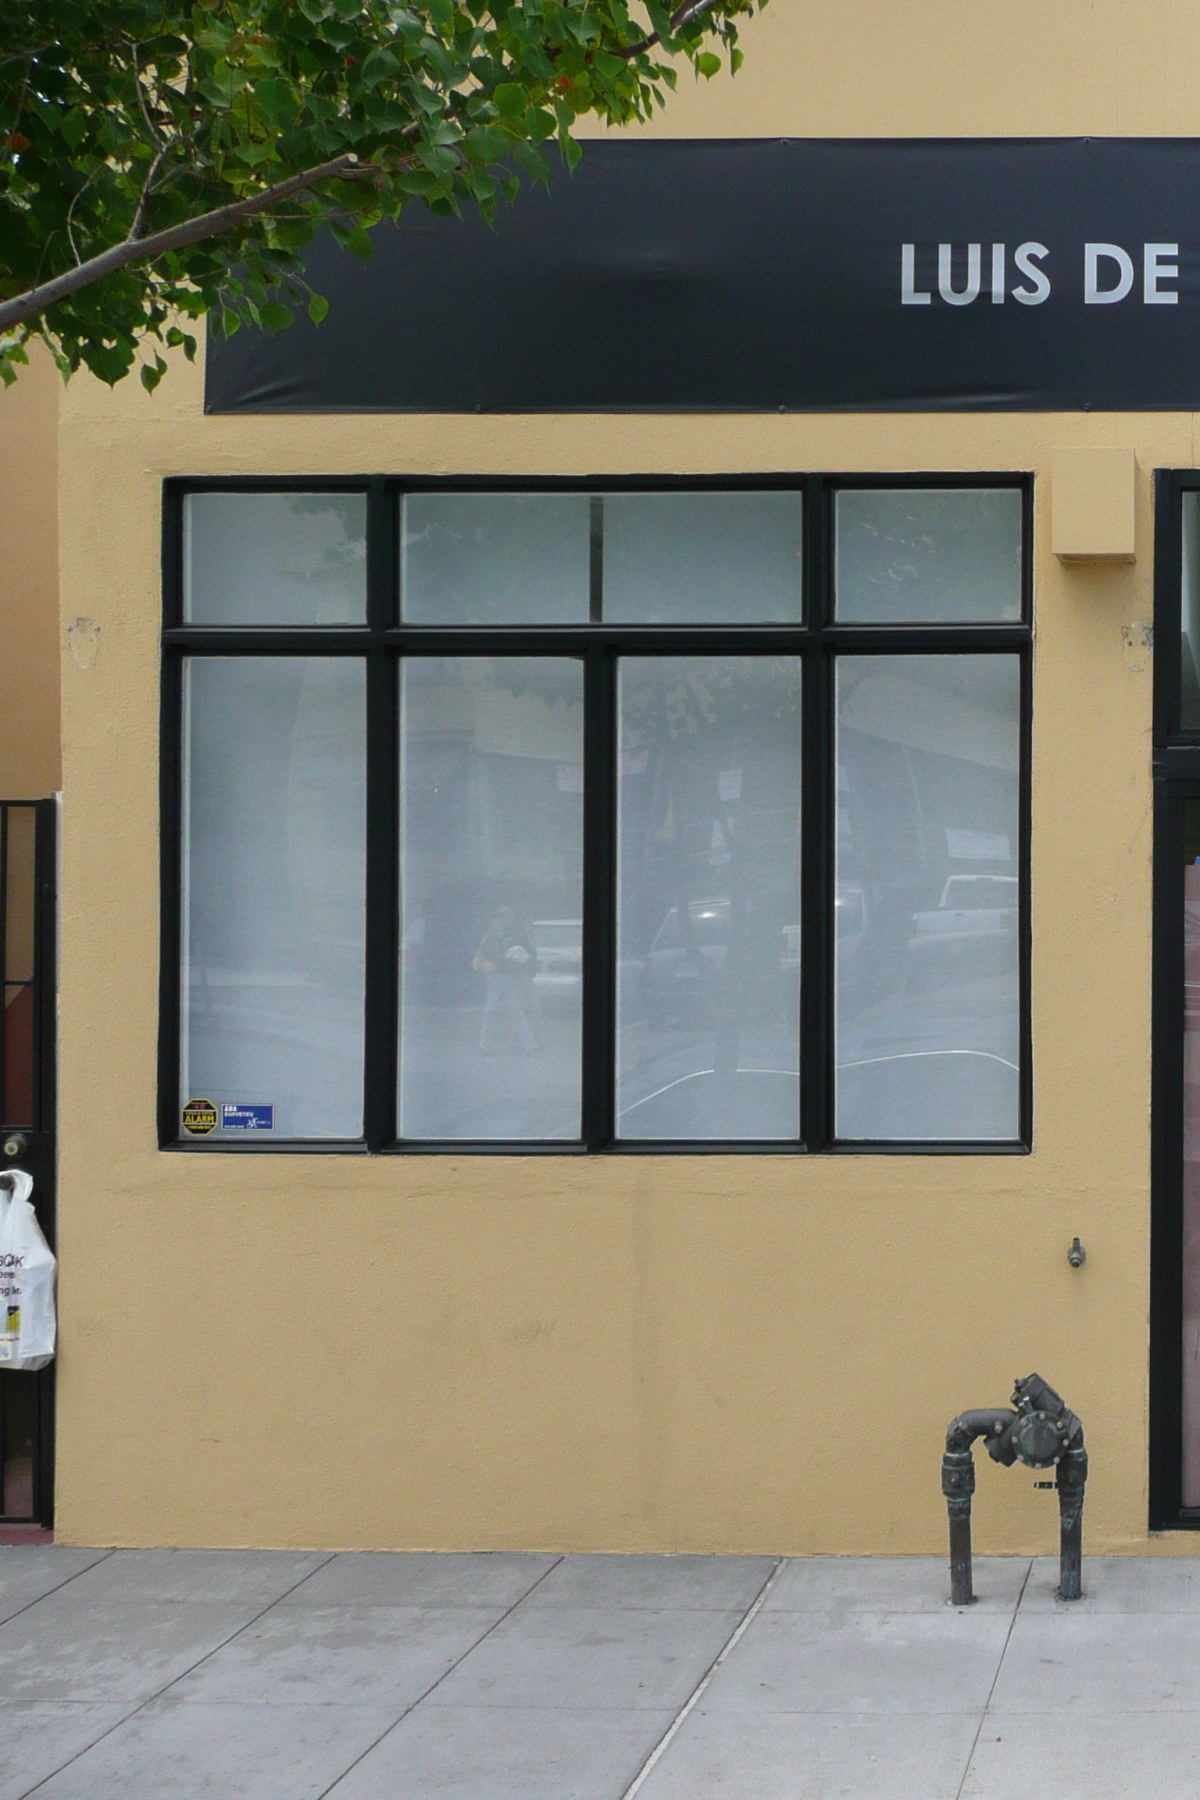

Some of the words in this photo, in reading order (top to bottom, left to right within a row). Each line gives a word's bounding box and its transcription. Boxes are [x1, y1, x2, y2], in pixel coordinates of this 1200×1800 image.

[901, 241, 1051, 306] LUIS
[1084, 242, 1179, 305] DE
[185, 1115, 215, 1123] ALARM
